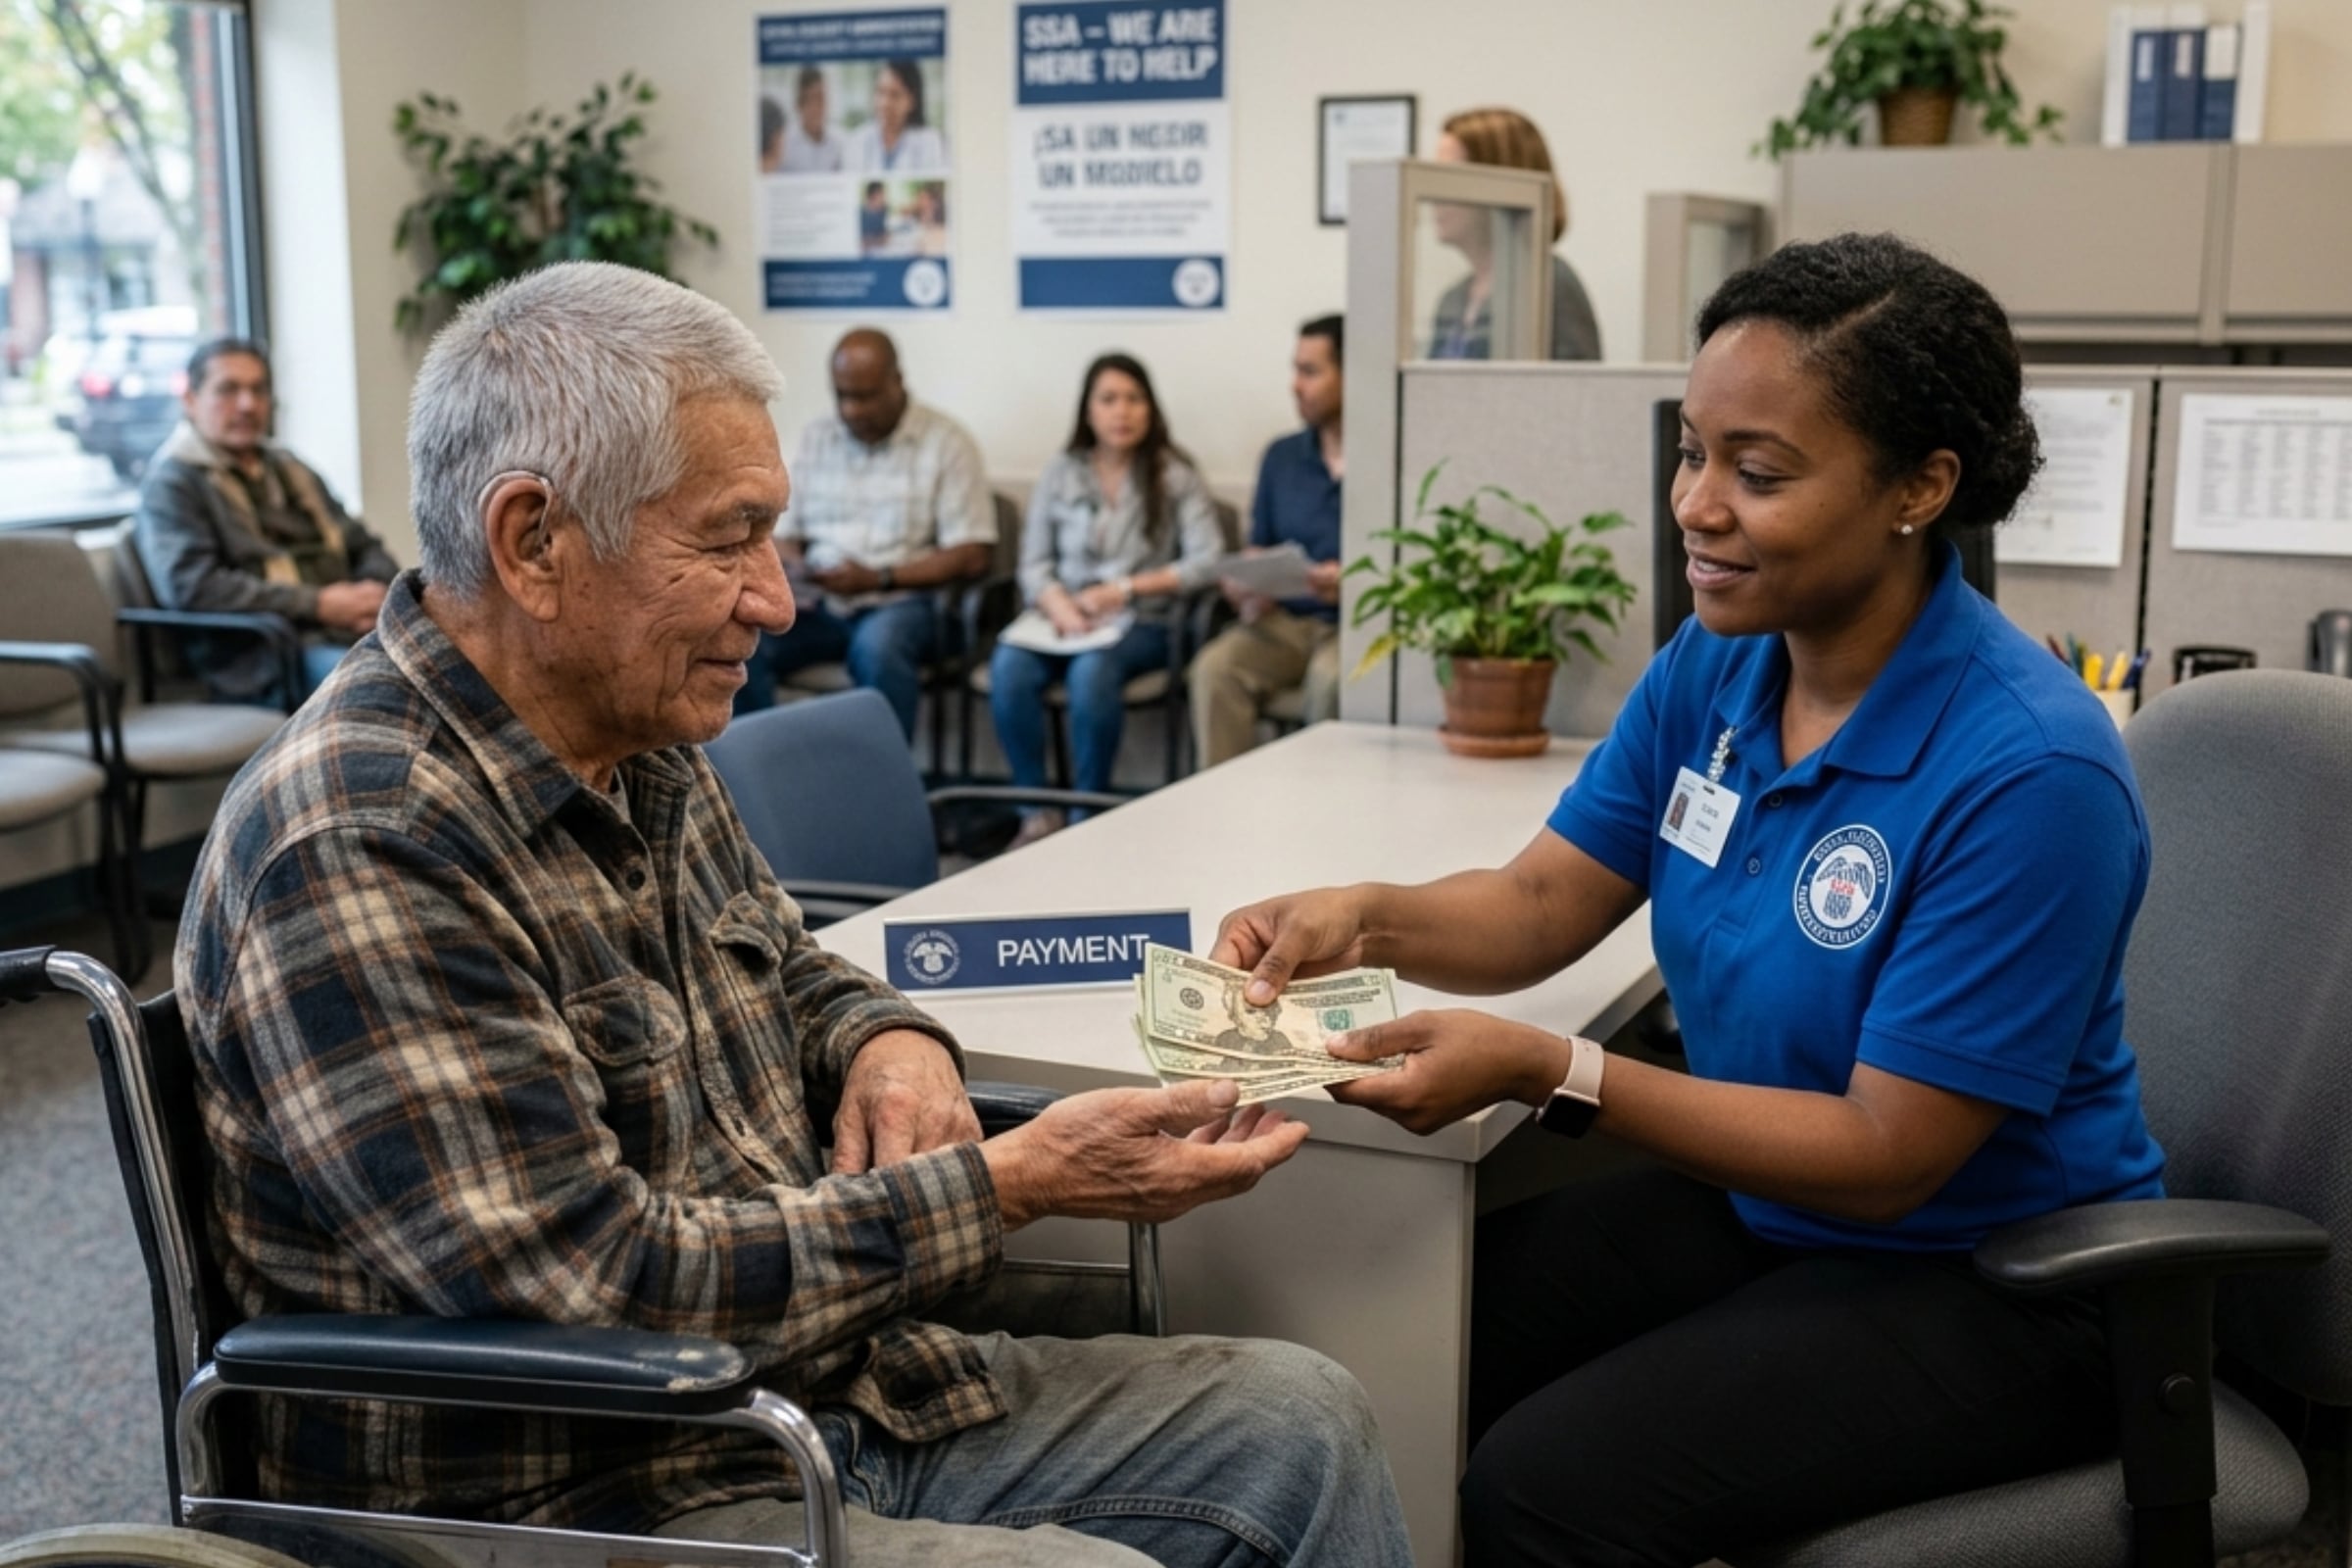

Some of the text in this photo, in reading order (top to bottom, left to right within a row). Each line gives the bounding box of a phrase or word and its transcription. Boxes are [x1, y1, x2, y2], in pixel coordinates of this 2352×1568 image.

[1024, 14, 1082, 48] SSA
[1106, 11, 1154, 45] WE
[1156, 8, 1217, 43] ARE
[1024, 45, 1217, 85] HERE TO HELP
[997, 933, 1151, 967] PAYMENT
